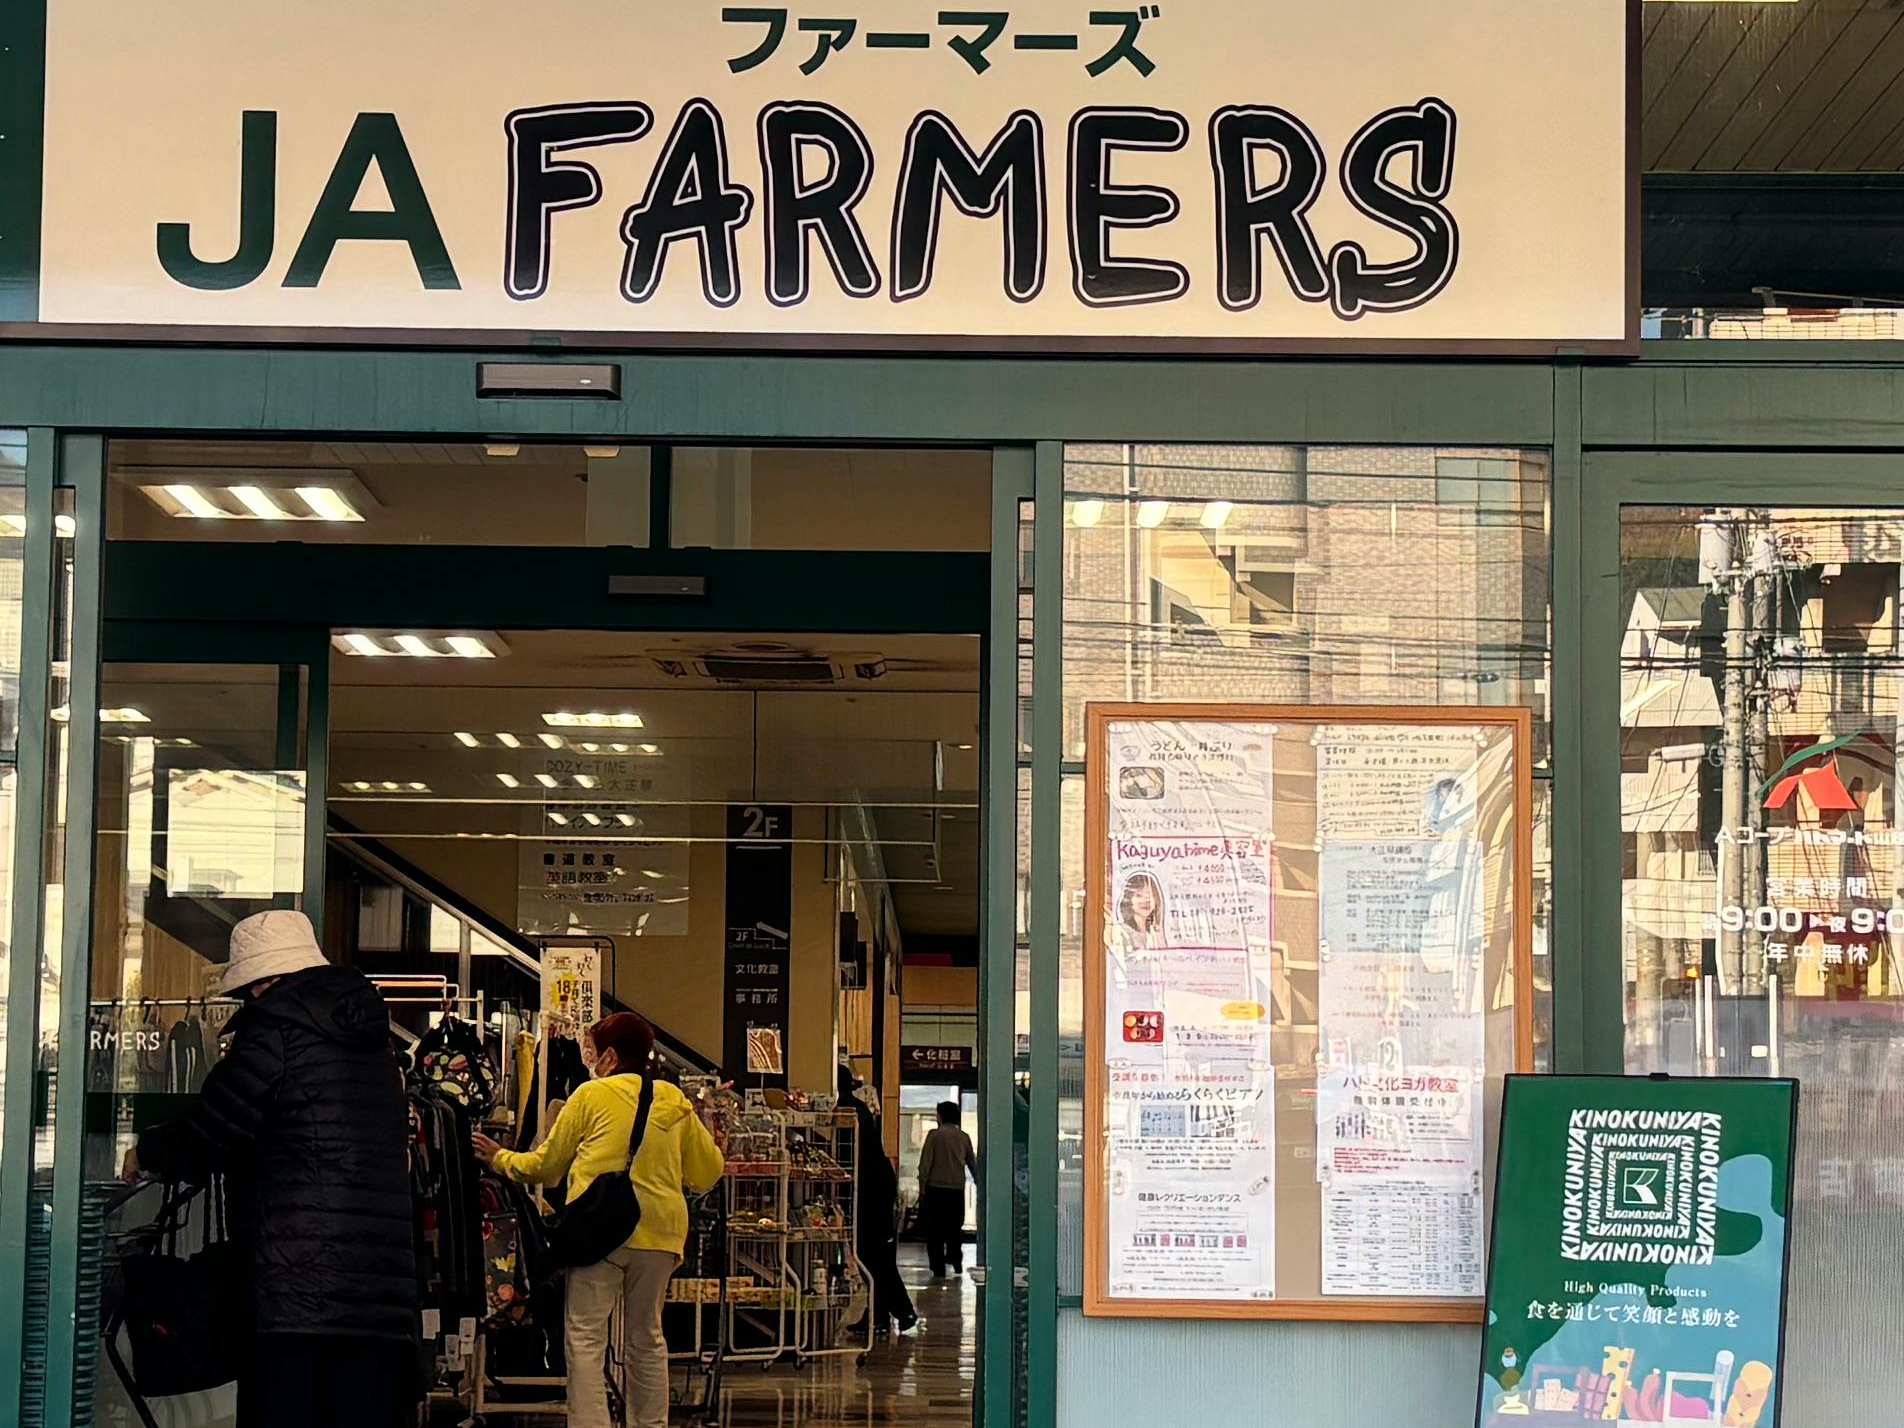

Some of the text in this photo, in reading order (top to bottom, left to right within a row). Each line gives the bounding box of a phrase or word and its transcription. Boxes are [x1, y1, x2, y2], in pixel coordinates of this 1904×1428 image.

[721, 4, 1162, 80] ファーマーズ
[154, 96, 1460, 322] JA FARMERS
[743, 807, 779, 838] 2F
[1766, 876, 1868, 898] 営業時間
[736, 932, 749, 941] 2F
[1765, 943, 1869, 964] 年中無休
[735, 964, 779, 975] 文化教室
[1569, 1109, 1703, 1130] KINOKUNIYA
[1592, 1133, 1683, 1148] KINOKUNIYA
[1586, 1145, 1605, 1236] KINOKUNIYA
[1678, 1135, 1695, 1229] KINOKUNIYA
[1695, 1112, 1723, 1247] KINOKUNIYA
[1561, 1127, 1588, 1260] KINOKUNIYA
[1599, 1222, 1690, 1239] KINOKUNIYA
[1580, 1241, 1715, 1265] KINOKUNIYA
[1564, 1280, 1707, 1298] High Quality Products
[1526, 1300, 1741, 1329] 食を通じて笑顔と感動を
